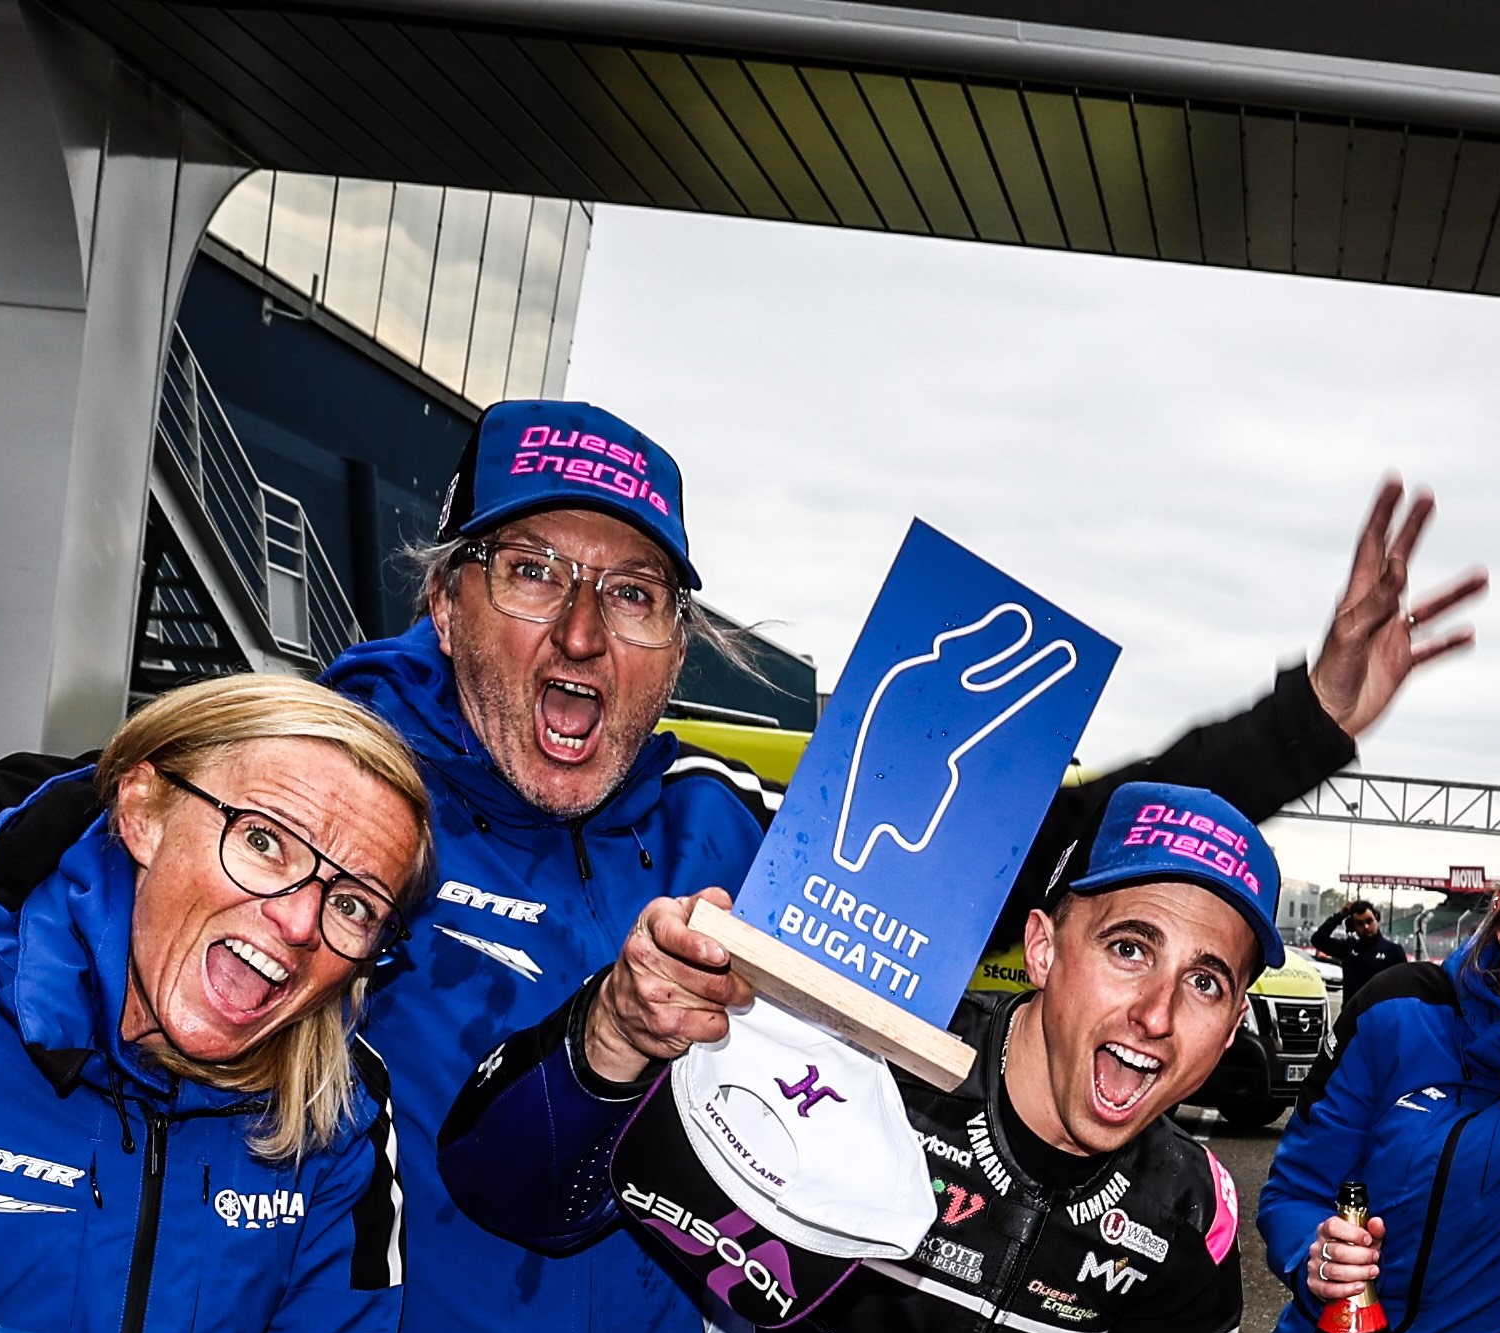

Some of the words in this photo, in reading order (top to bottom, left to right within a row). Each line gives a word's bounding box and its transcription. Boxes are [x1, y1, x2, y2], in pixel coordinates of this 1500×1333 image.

[510, 451, 669, 516] Energie
[1123, 827, 1262, 895] Energie
[1451, 869, 1484, 889] MOTUL
[437, 881, 547, 923] GYTR
[803, 875, 930, 959] CIRCUIT
[779, 904, 921, 1000] BUGATTI
[983, 964, 1031, 984] SÉCURI
[705, 1103, 751, 1160] VICTORY
[749, 1159, 787, 1187] LANE
[916, 1131, 975, 1169] ytona
[966, 1112, 1012, 1196] YAMAHA
[1066, 1171, 1131, 1225] YAMAHA
[622, 1183, 794, 1318] HOOSIER
